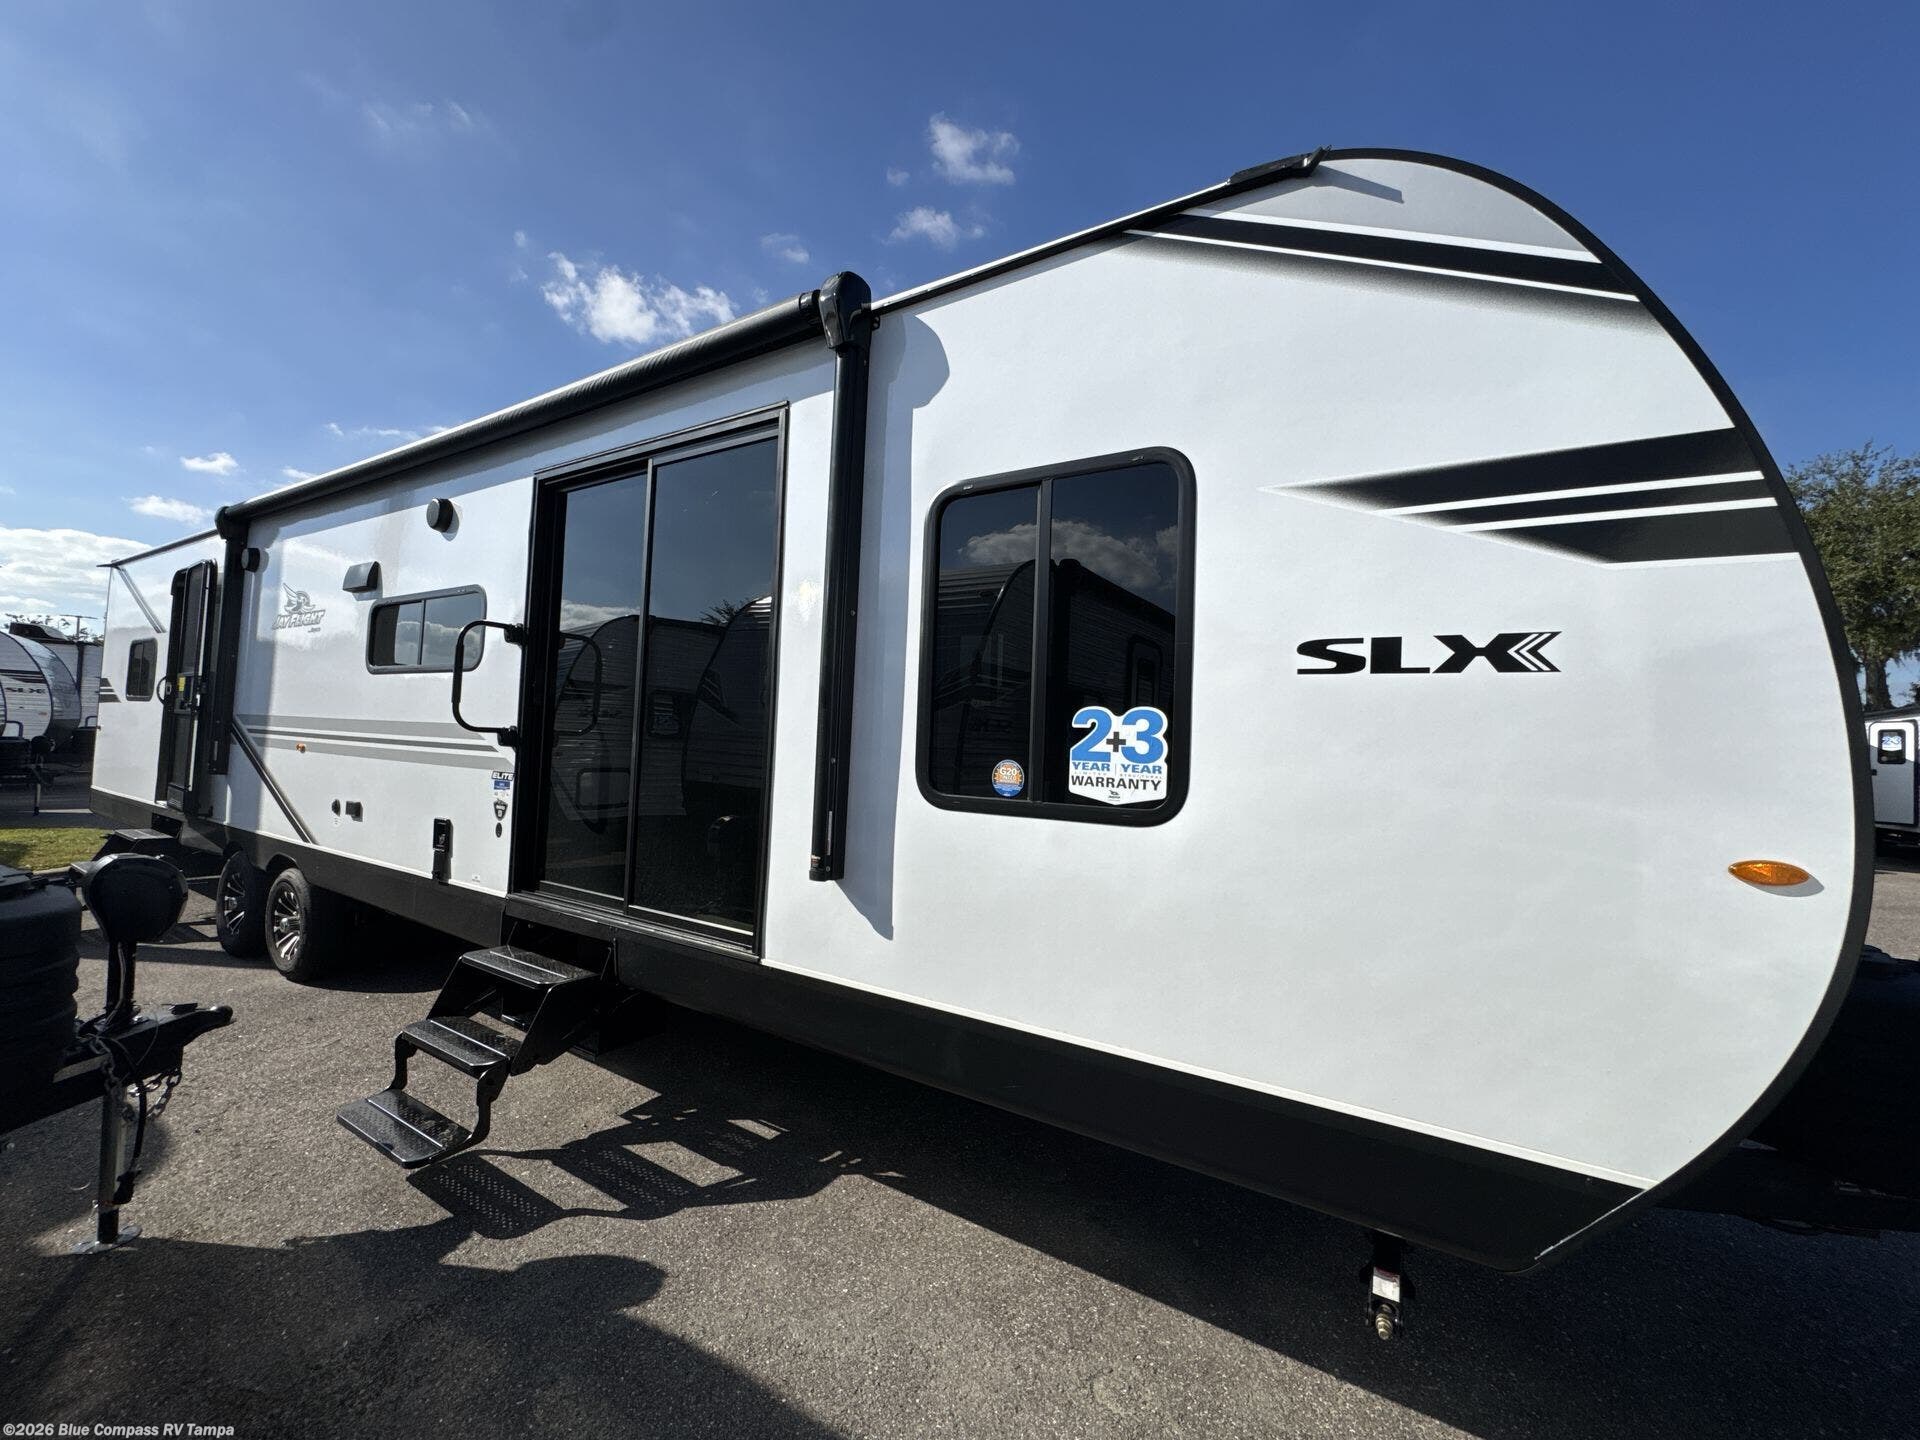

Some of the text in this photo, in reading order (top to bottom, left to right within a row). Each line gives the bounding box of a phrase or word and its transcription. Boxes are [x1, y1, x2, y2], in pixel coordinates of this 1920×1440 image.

[1296, 631, 1562, 675] SLX
[1072, 762, 1163, 775] YEAR YEAR
[492, 771, 514, 781] ELITE
[1071, 775, 1162, 791] WARRANTY
